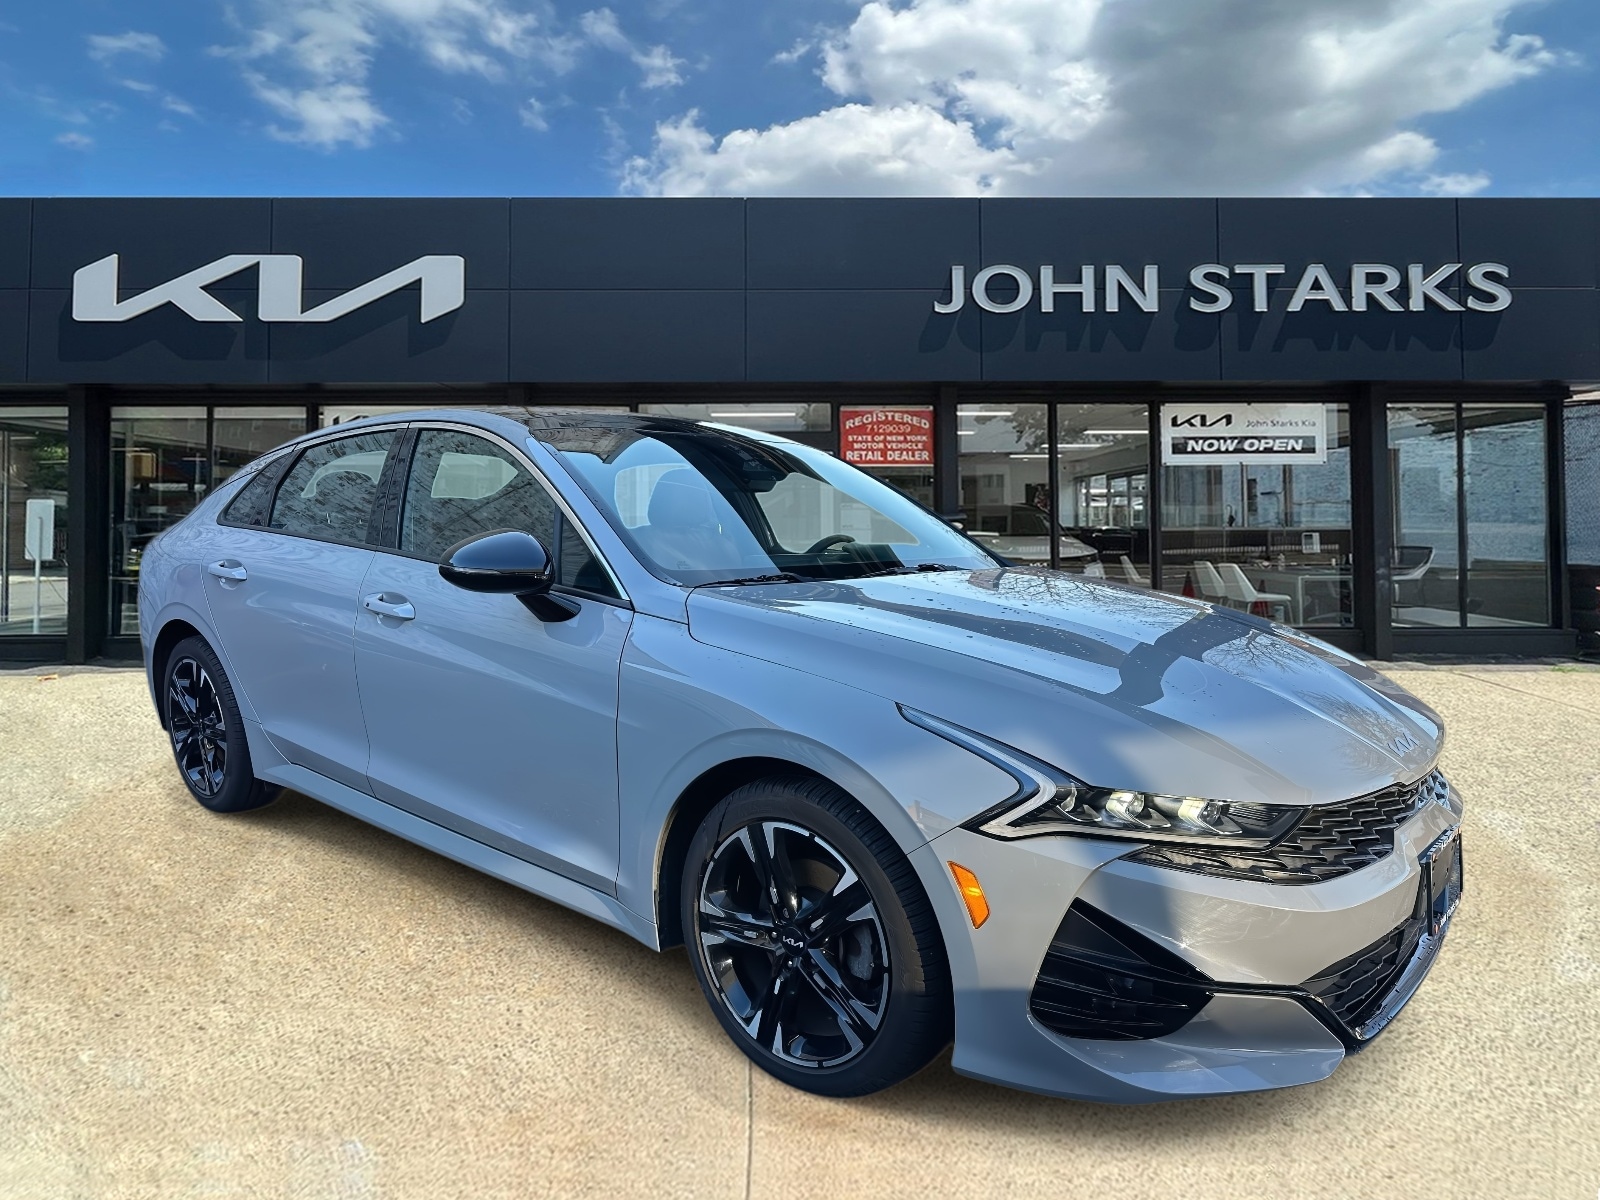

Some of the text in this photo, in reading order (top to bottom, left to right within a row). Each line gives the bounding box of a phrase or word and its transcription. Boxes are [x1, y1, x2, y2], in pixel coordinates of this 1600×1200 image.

[933, 263, 1512, 314] JOHN STARKS
[845, 411, 930, 429] REGISTERED
[1246, 420, 1269, 428] John
[1270, 419, 1299, 428] Starks
[866, 424, 911, 433] 7129039
[1187, 439, 1303, 452] NOW OPEN
[846, 451, 929, 461] RETAIL DEALER
